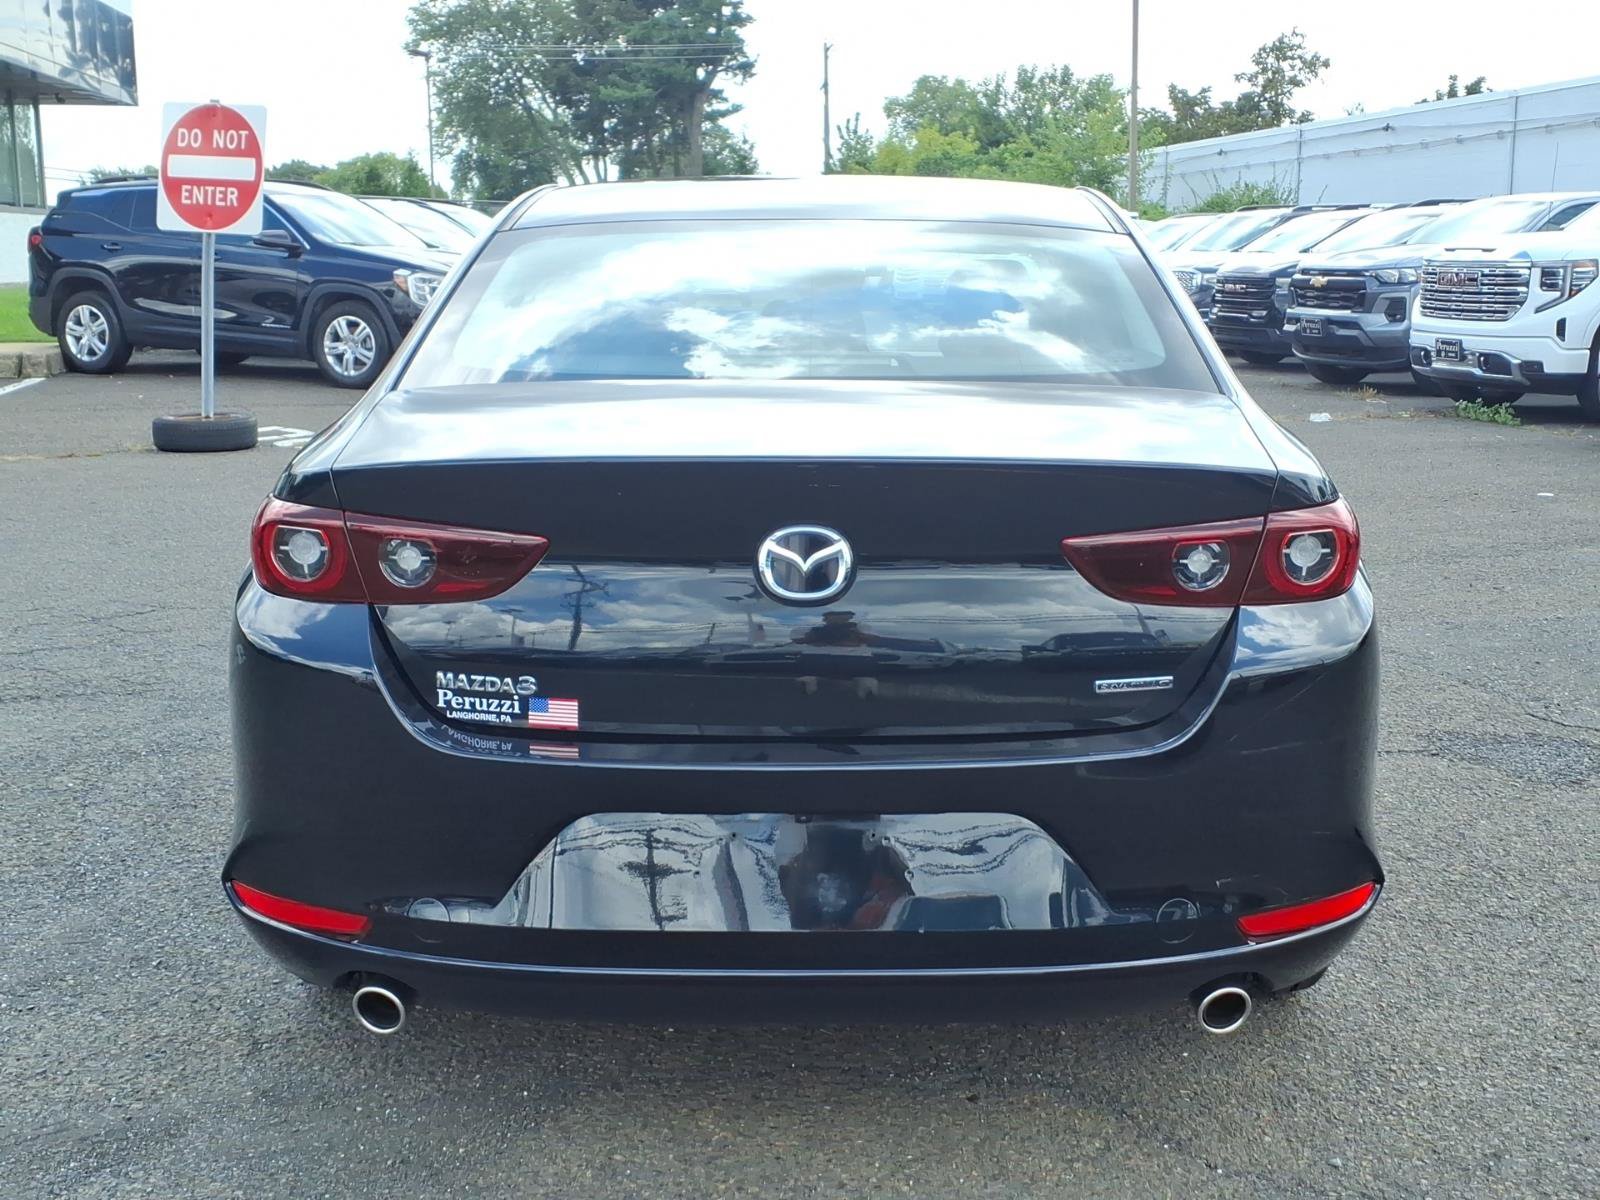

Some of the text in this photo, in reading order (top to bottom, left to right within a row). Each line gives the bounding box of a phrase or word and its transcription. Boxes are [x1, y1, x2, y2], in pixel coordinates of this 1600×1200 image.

[177, 127, 249, 150] DO NOT
[181, 184, 239, 207] ENTER
[1439, 272, 1478, 286] GMC
[435, 670, 538, 695] MAZDA3
[436, 689, 521, 714] Peruzzi
[446, 710, 512, 723] LANGHORNE, PA
